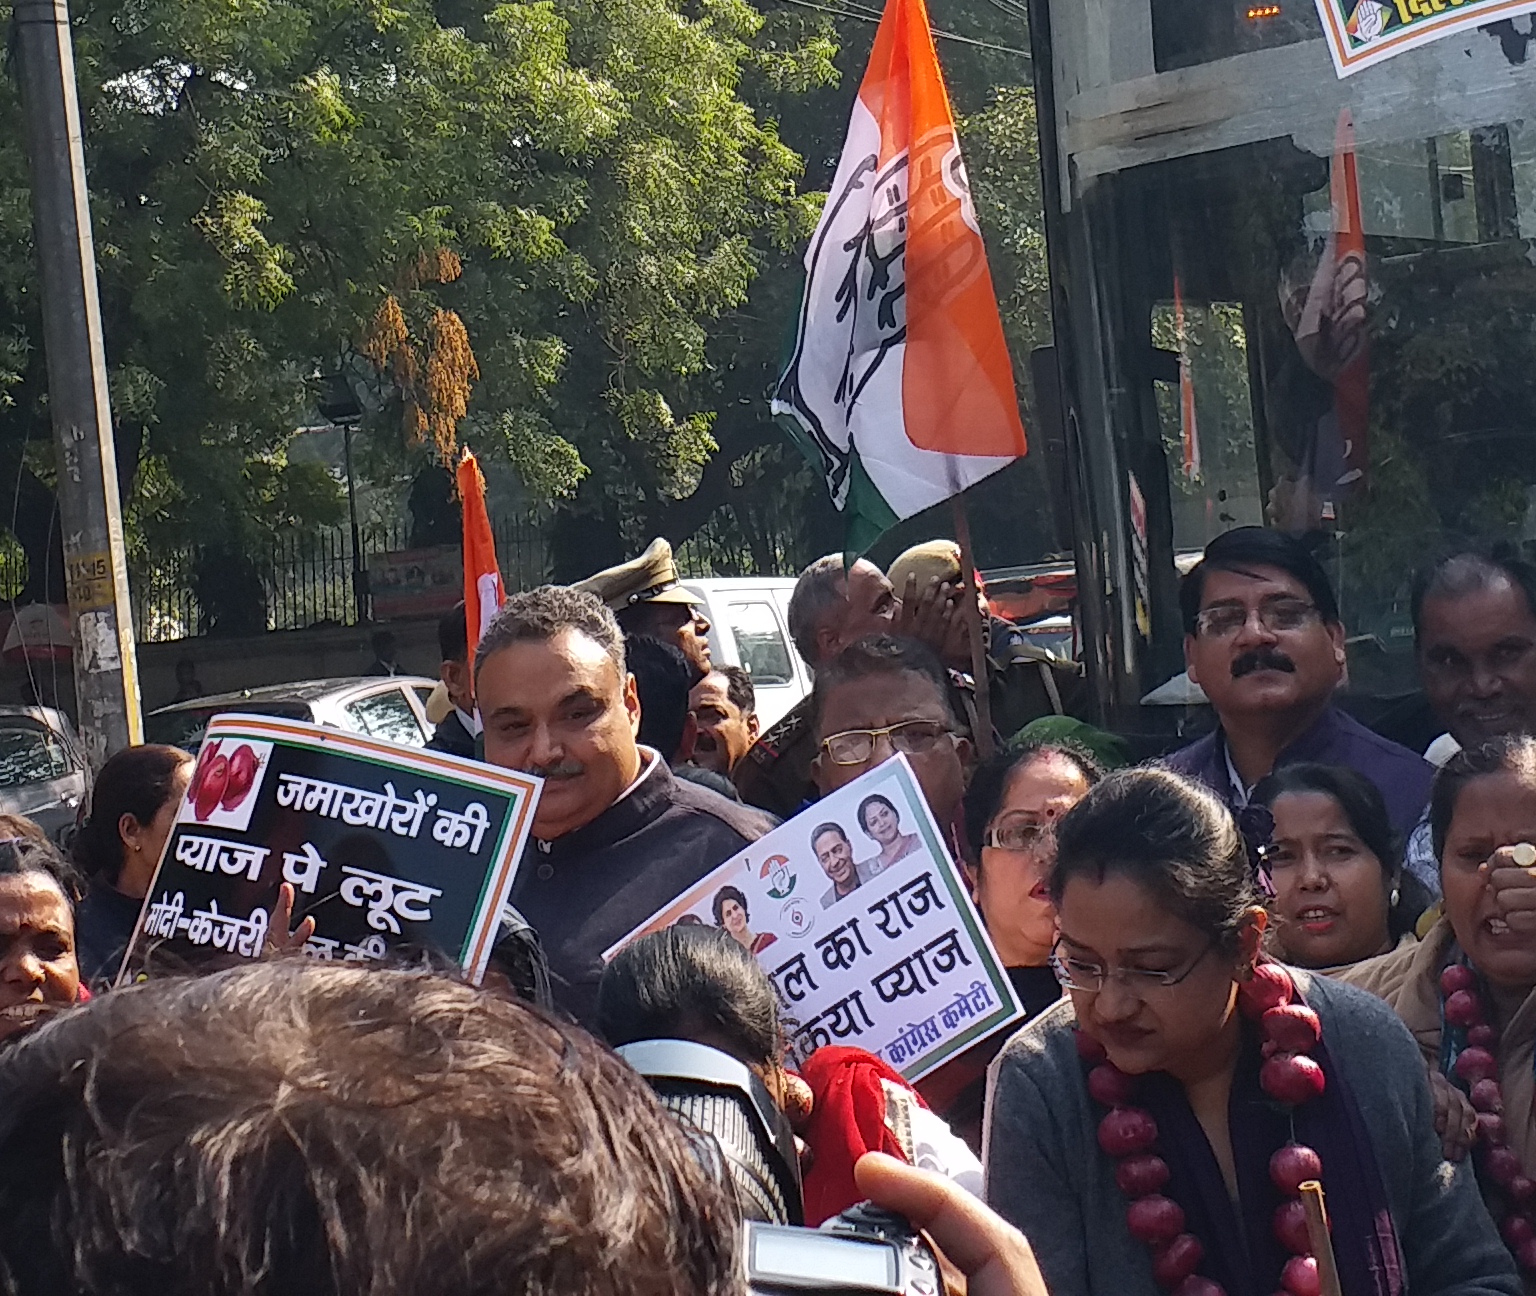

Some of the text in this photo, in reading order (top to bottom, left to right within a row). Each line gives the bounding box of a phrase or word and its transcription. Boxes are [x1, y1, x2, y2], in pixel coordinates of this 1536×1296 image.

[276, 772, 491, 855] जमाखोरों की
[175, 834, 444, 935] प्याज पे लूट
[814, 917, 872, 970] का
[867, 871, 946, 939] राज
[870, 928, 972, 1003] प्याज
[884, 980, 995, 1065] कांग्रेस कमेटी
